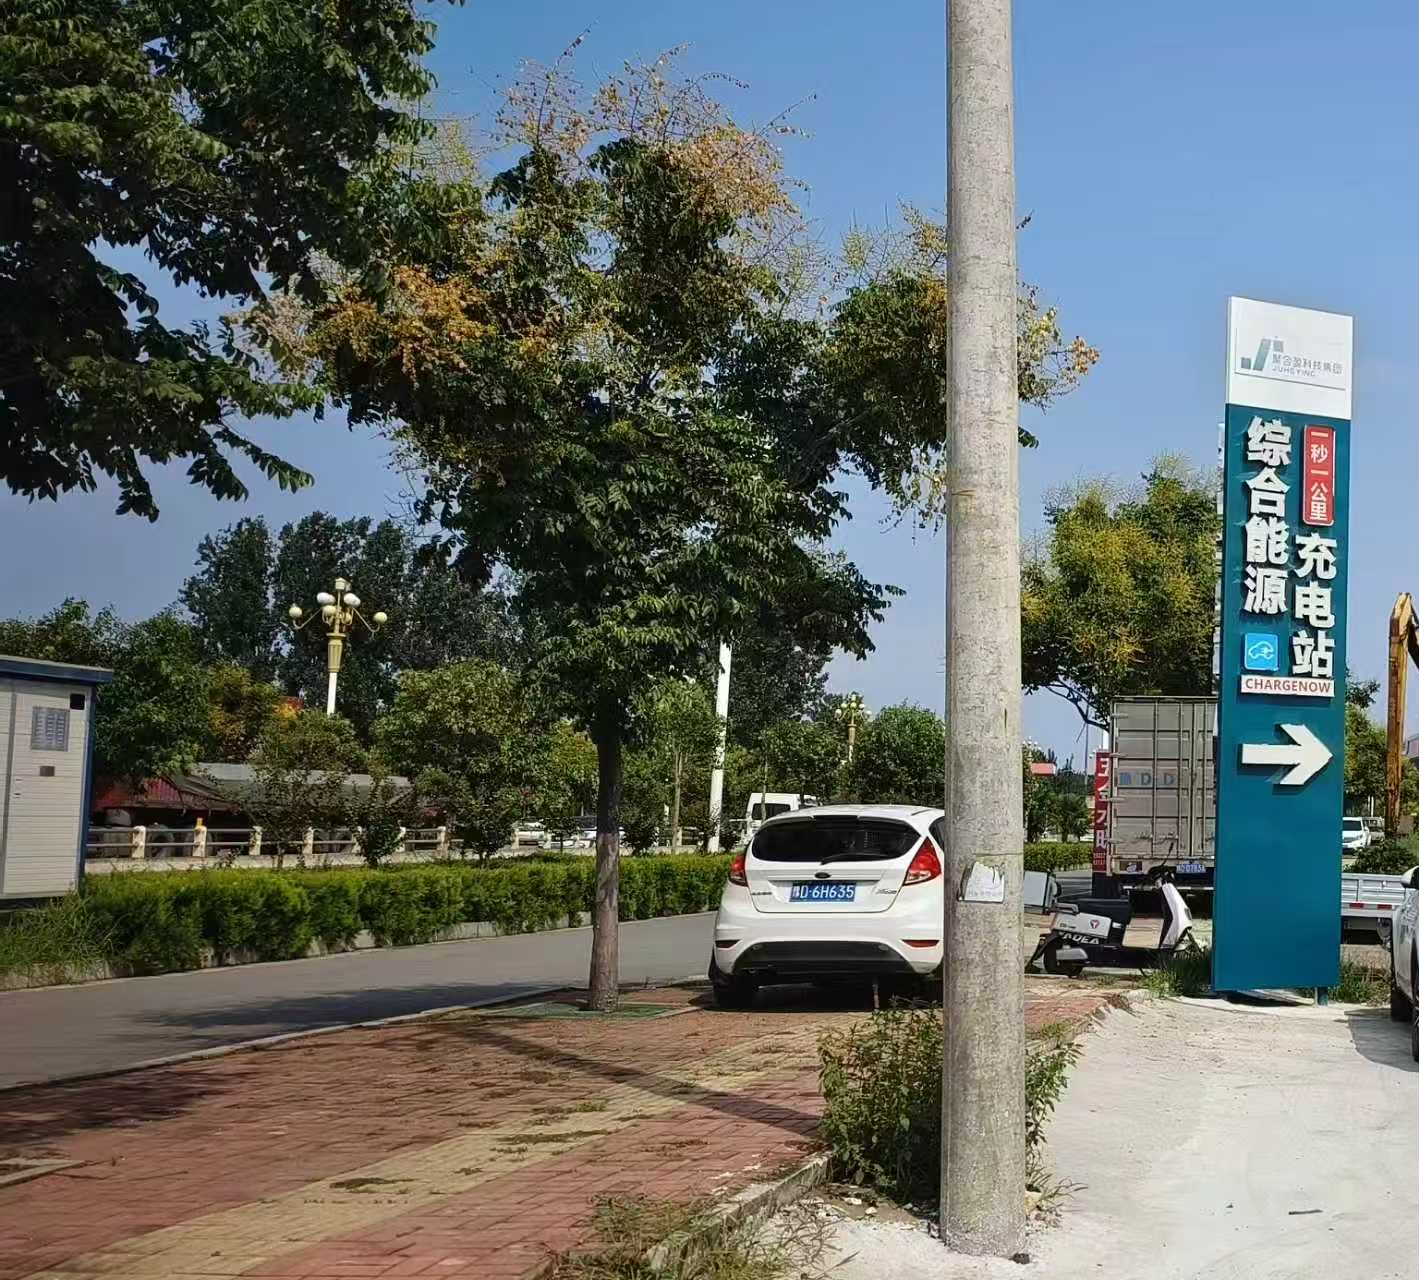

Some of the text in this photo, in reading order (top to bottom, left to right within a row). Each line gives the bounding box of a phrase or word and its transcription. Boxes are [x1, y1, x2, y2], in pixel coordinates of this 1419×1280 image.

[1243, 416, 1292, 615] 综合能源
[1310, 431, 1329, 522] 一秒一公里
[1292, 532, 1338, 679] 充电站
[1245, 677, 1331, 694] CHARGENOW
